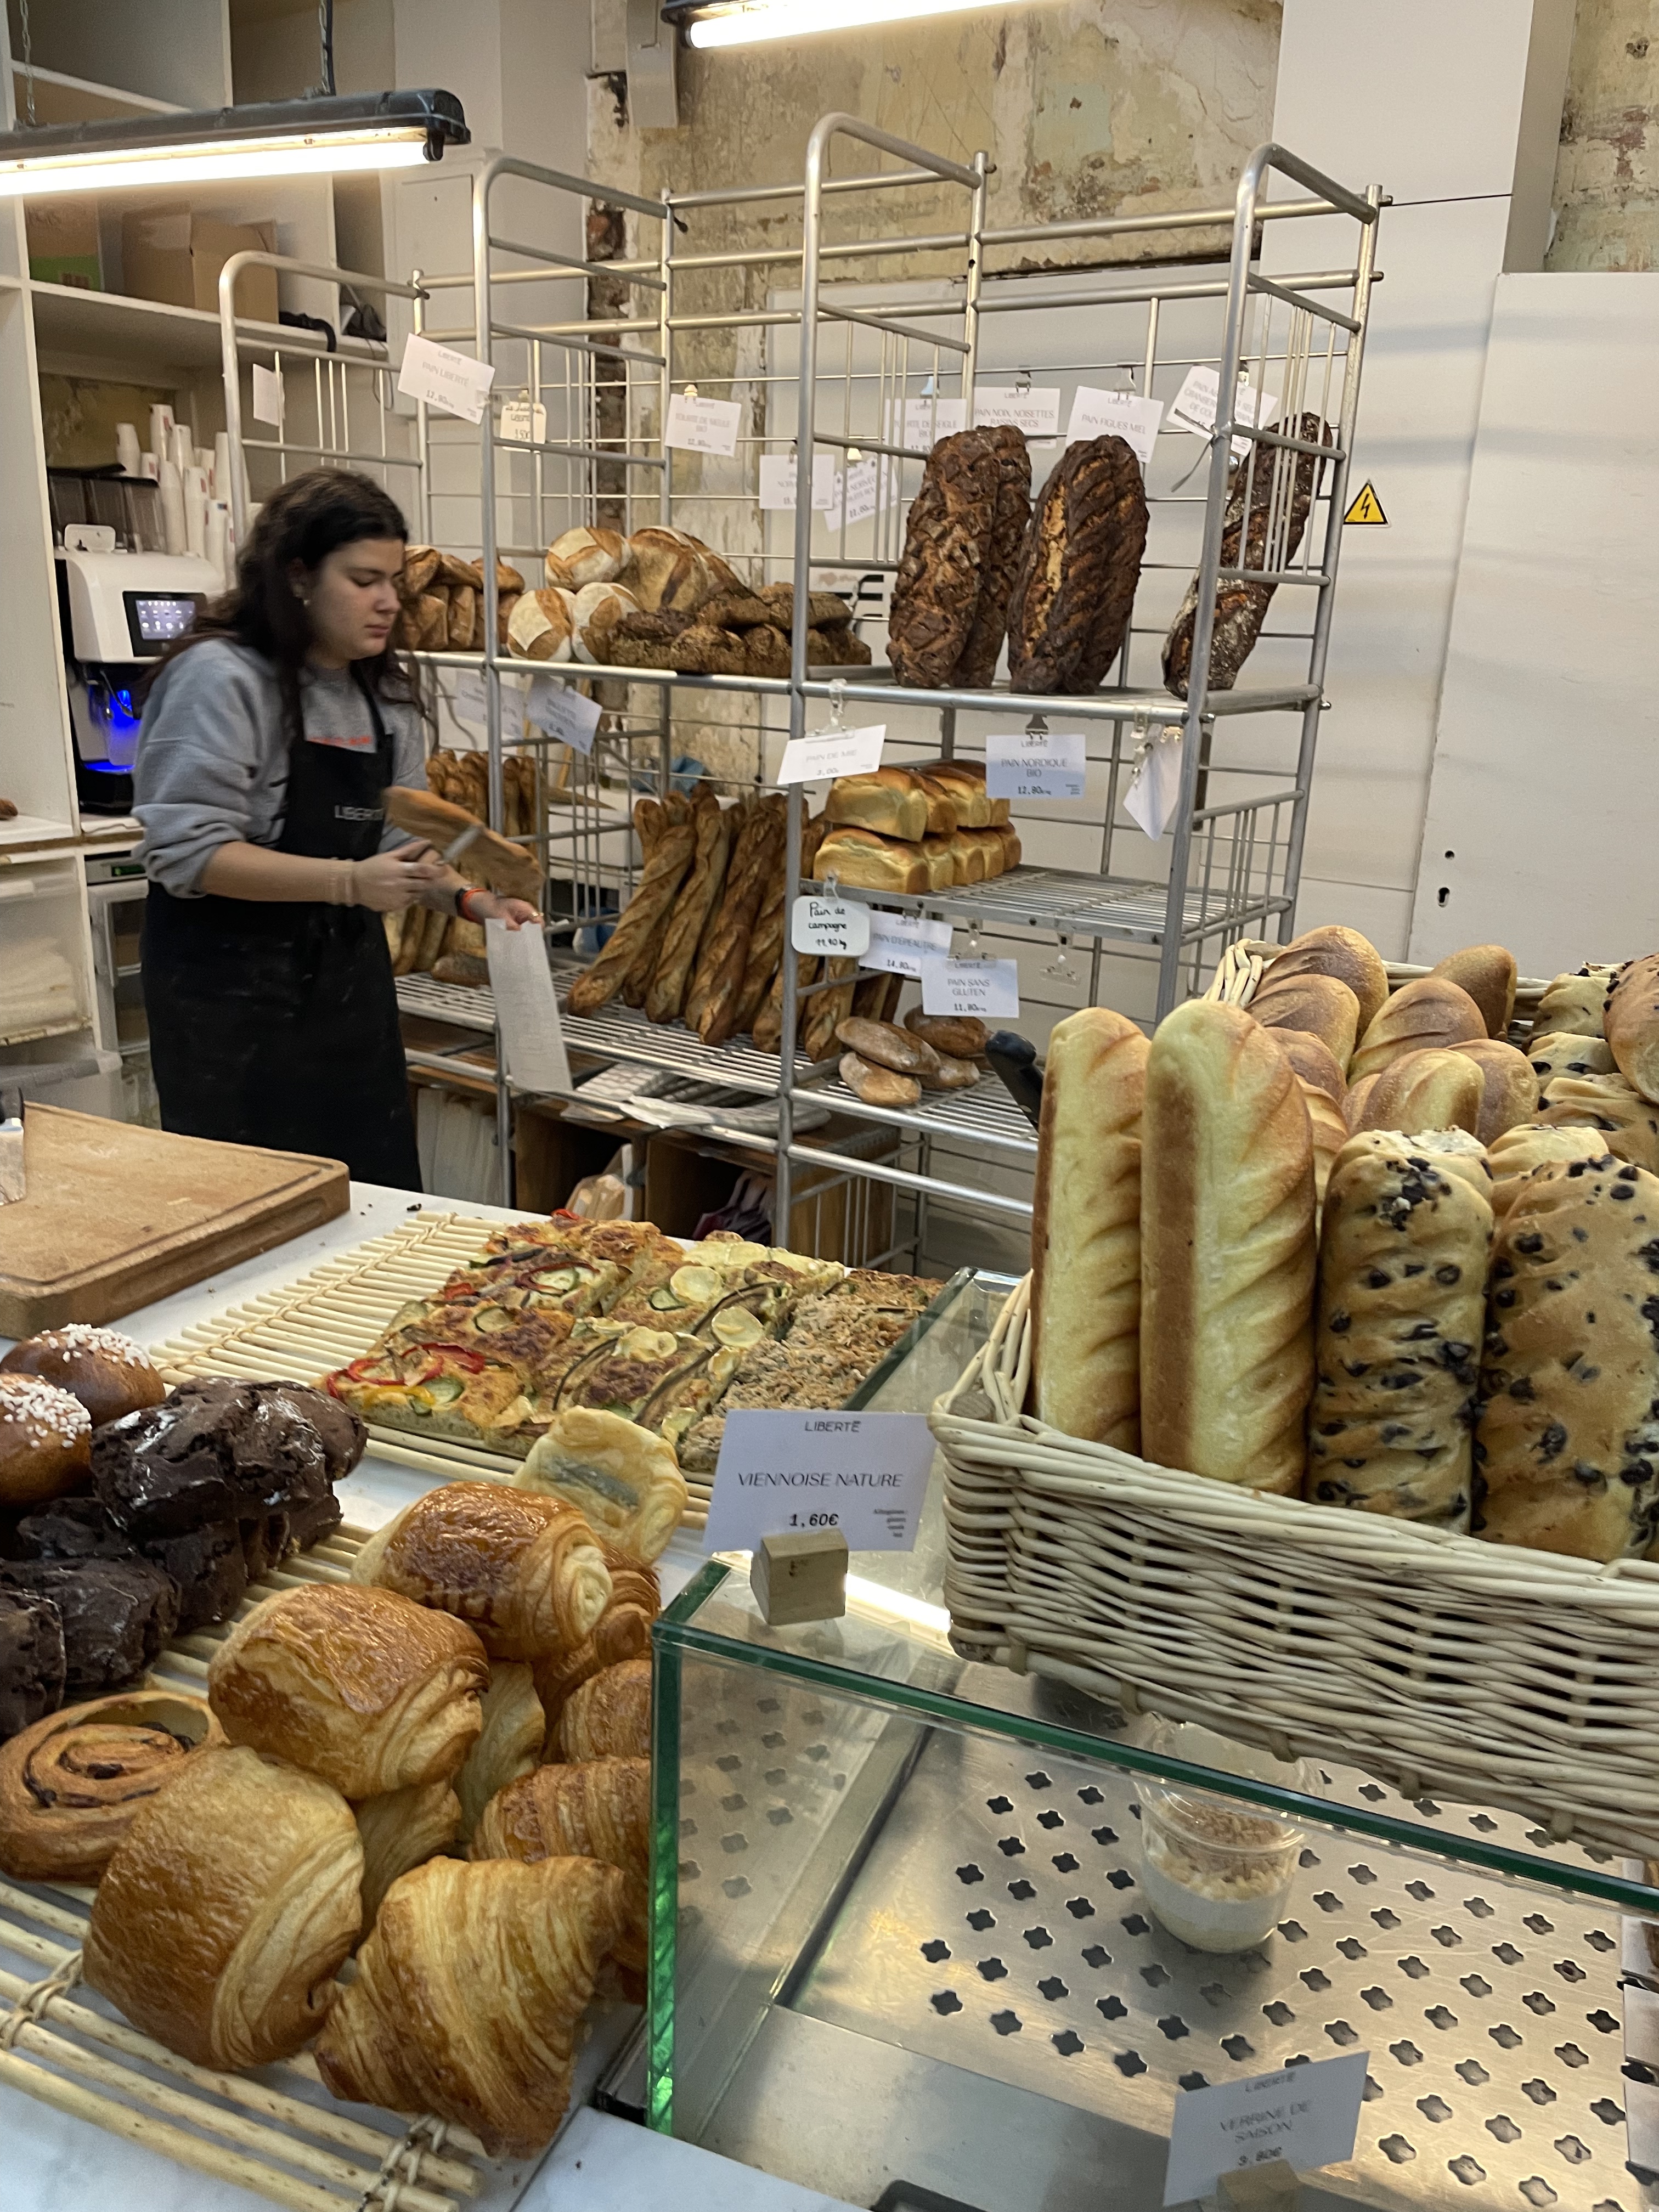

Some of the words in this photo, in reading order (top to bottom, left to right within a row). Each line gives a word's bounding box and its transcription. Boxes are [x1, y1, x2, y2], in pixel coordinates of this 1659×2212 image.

[827, 751, 839, 759] DE
[1021, 758, 1068, 768] NORDIQUE
[1026, 769, 1042, 777] BIO
[809, 901, 831, 917] Pain
[834, 906, 845, 915] de
[808, 922, 848, 932] campagne
[967, 978, 990, 987] SANS
[952, 988, 986, 996] GLUTEN
[805, 1420, 862, 1433] LIBERTÉ
[738, 1472, 834, 1487] VIENNOISE
[836, 1472, 905, 1487] NATURE
[788, 1513, 839, 1527] 1,60€
